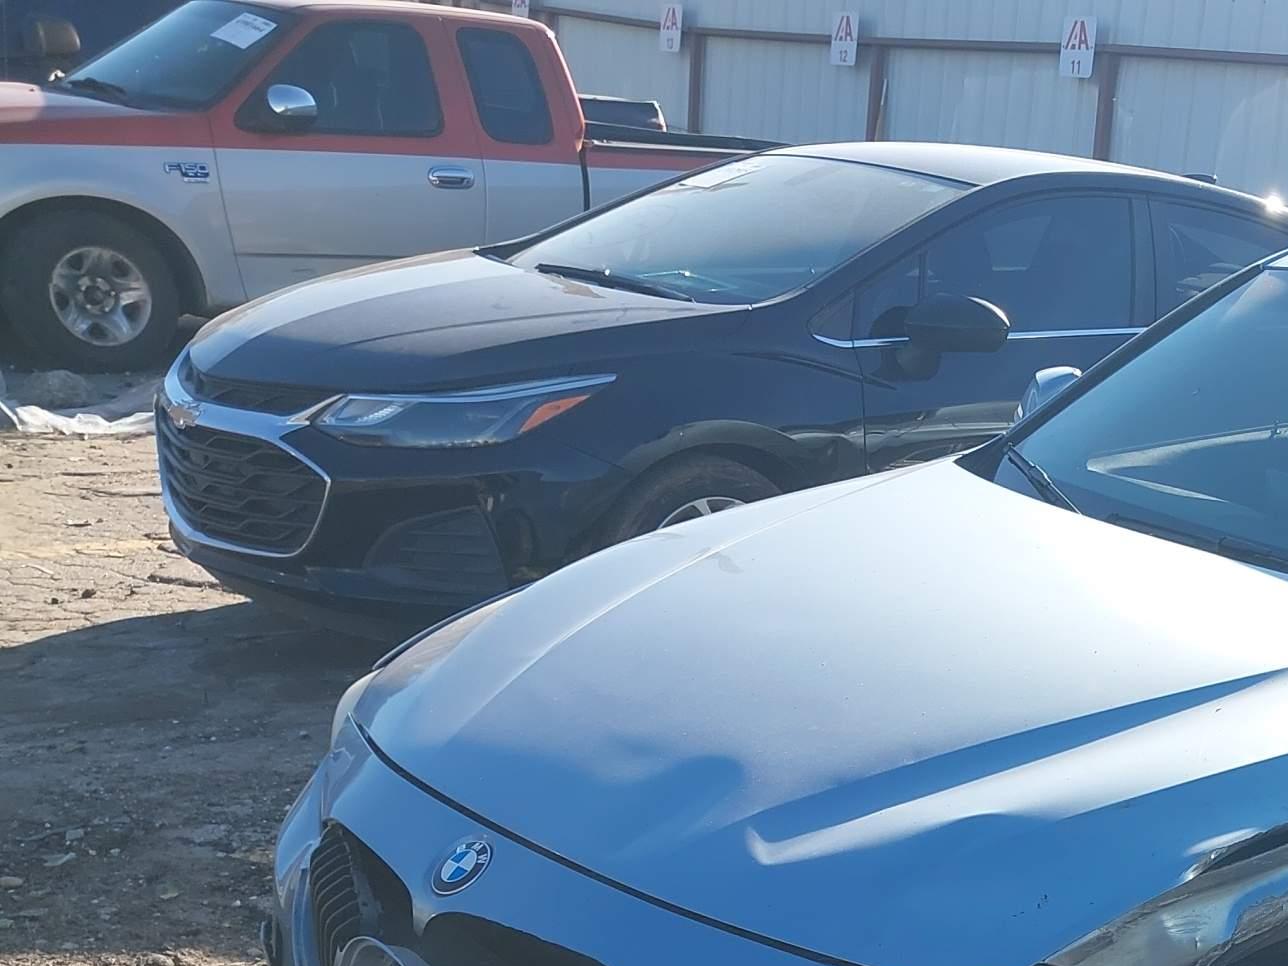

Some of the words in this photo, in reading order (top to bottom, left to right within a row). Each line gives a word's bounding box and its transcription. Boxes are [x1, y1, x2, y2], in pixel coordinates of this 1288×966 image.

[840, 50, 848, 62] 12
[1071, 60, 1081, 75] 11
[456, 843, 489, 864] BMW
